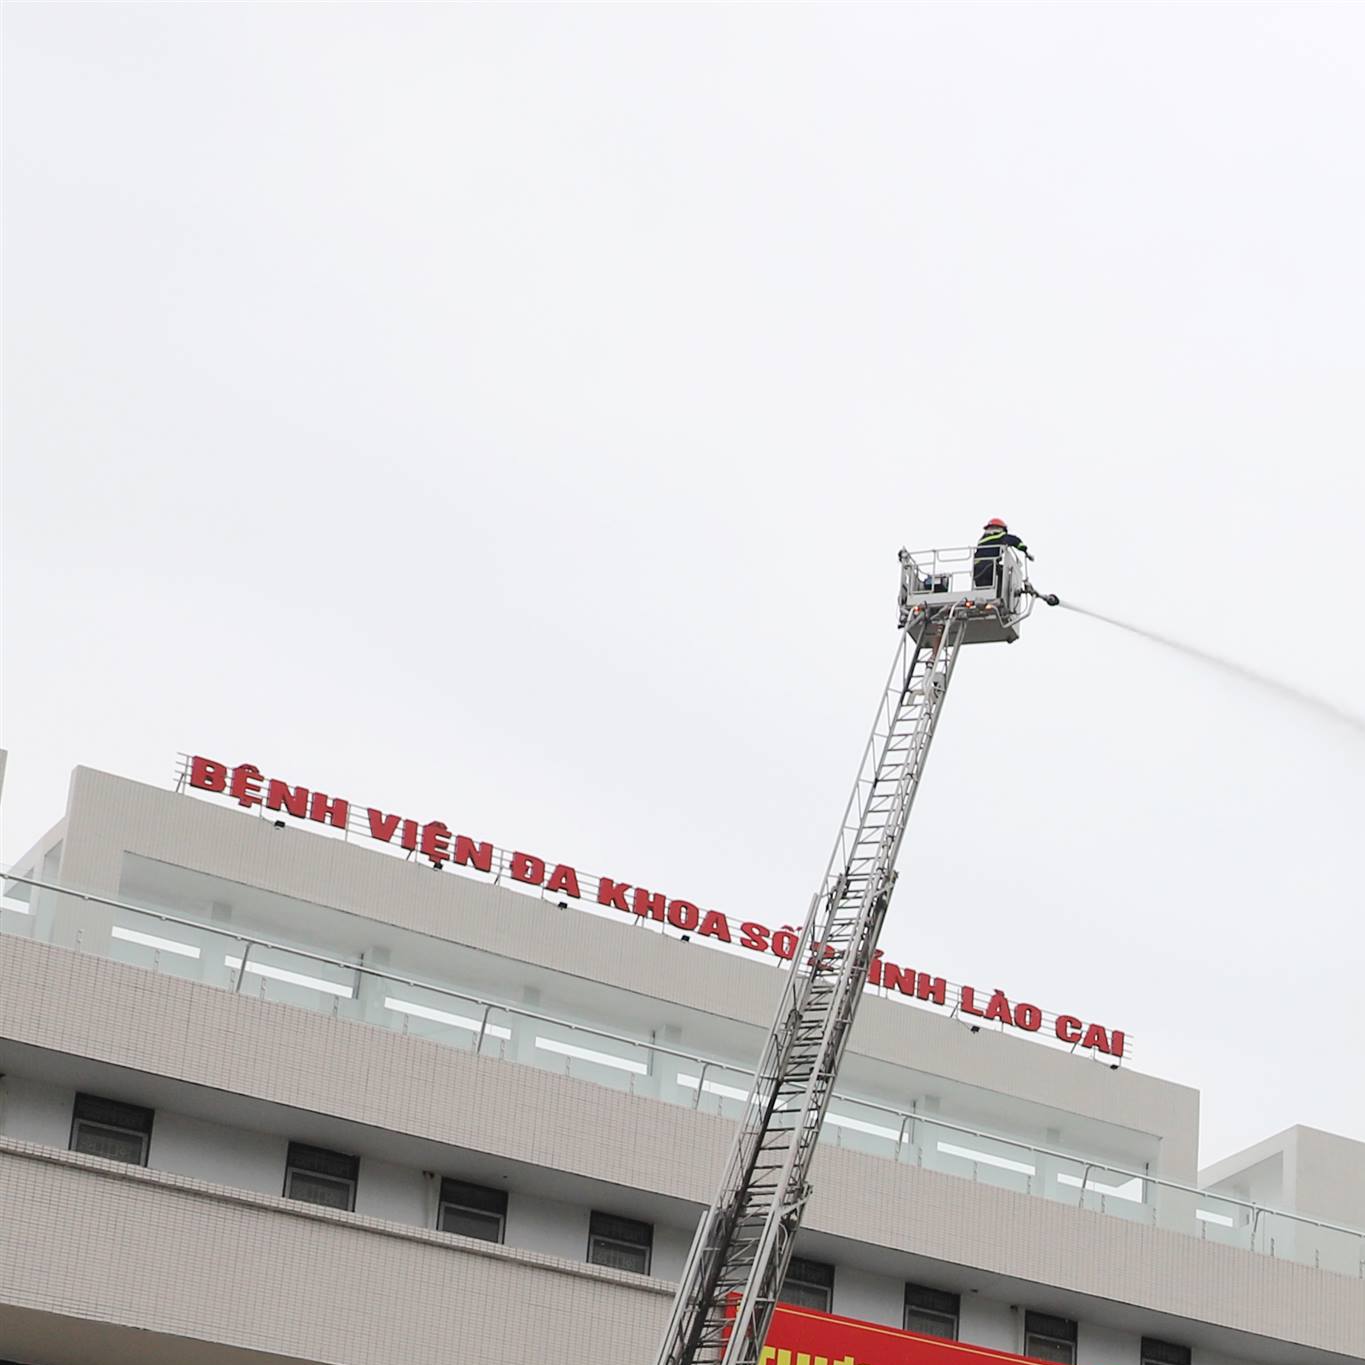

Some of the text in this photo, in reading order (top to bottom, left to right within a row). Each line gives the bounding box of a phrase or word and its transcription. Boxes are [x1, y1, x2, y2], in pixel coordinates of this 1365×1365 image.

[190, 756, 348, 829] BỆNH
[368, 808, 494, 872] VIỆN
[511, 852, 580, 898] ĐA
[599, 878, 730, 942] KHOA
[868, 948, 946, 1004] ỈNH
[962, 987, 1040, 1031] LÀO
[1056, 1016, 1123, 1057] CAI
